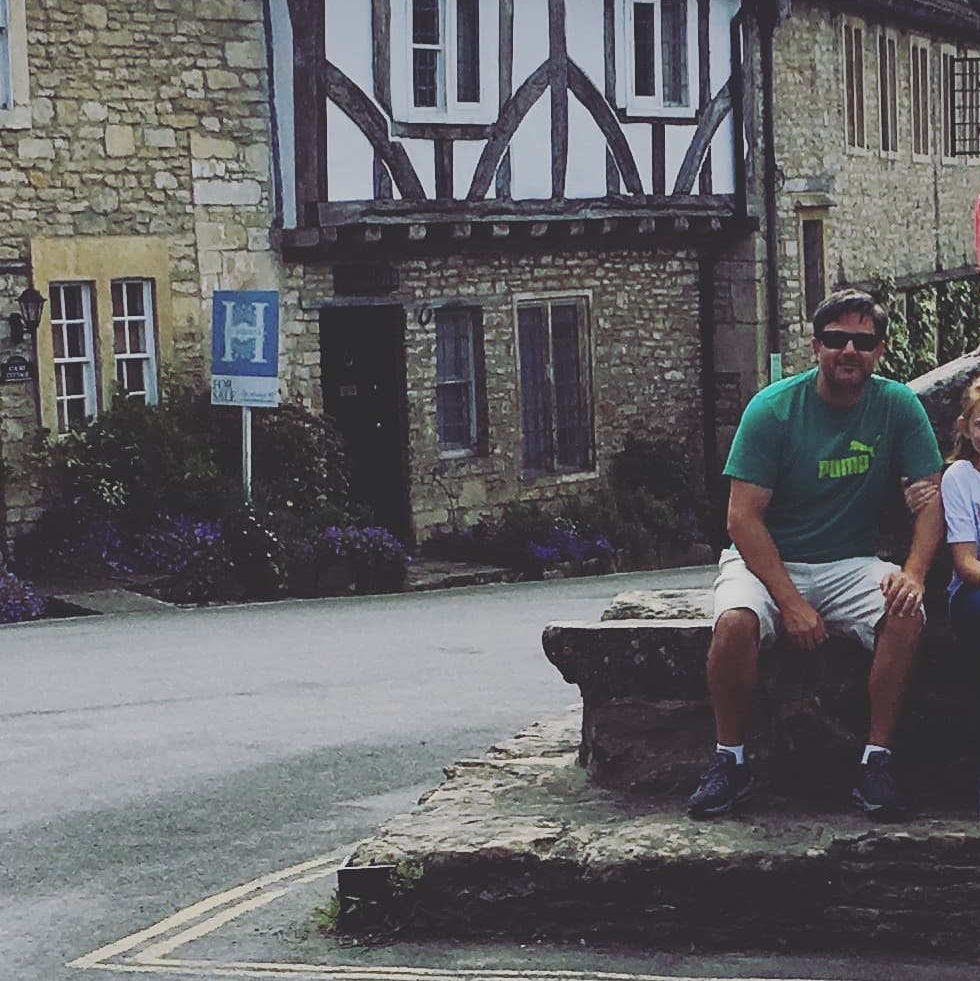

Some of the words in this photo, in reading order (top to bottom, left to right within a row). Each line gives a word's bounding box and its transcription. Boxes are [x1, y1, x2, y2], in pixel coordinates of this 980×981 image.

[221, 300, 270, 363] H
[213, 388, 237, 402] SALE
[818, 455, 869, 479] PUMA
